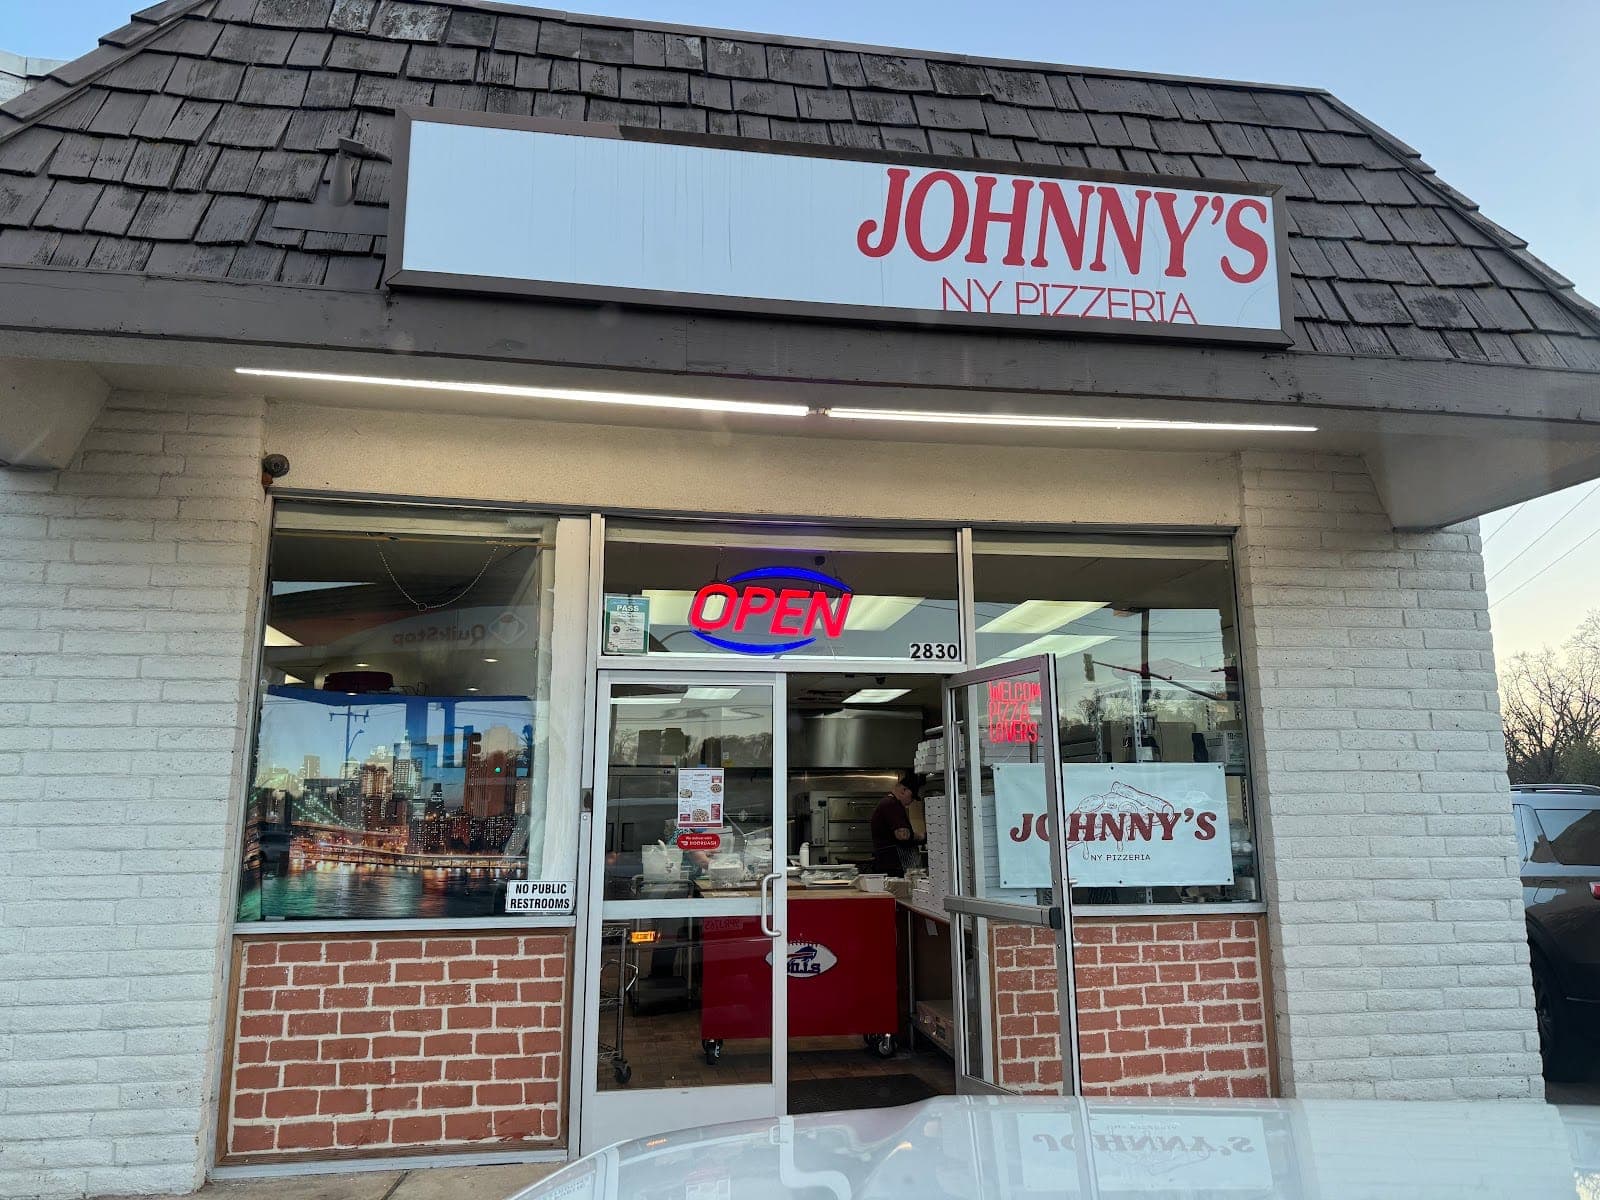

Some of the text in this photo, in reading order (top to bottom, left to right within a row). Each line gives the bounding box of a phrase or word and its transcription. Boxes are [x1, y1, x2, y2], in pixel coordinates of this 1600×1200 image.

[857, 168, 1269, 284] JOHNNY'S
[942, 277, 1200, 325] NY PIZZERIA
[616, 604, 640, 612] PASS
[688, 582, 854, 639] OPEN
[910, 643, 958, 659] 2830
[988, 681, 1041, 701] WELCOM
[988, 701, 1030, 721] PIZZA
[515, 883, 567, 895] NO PUBLIC
[510, 897, 570, 910] RESTROOMS
[787, 961, 821, 974] ILLS
